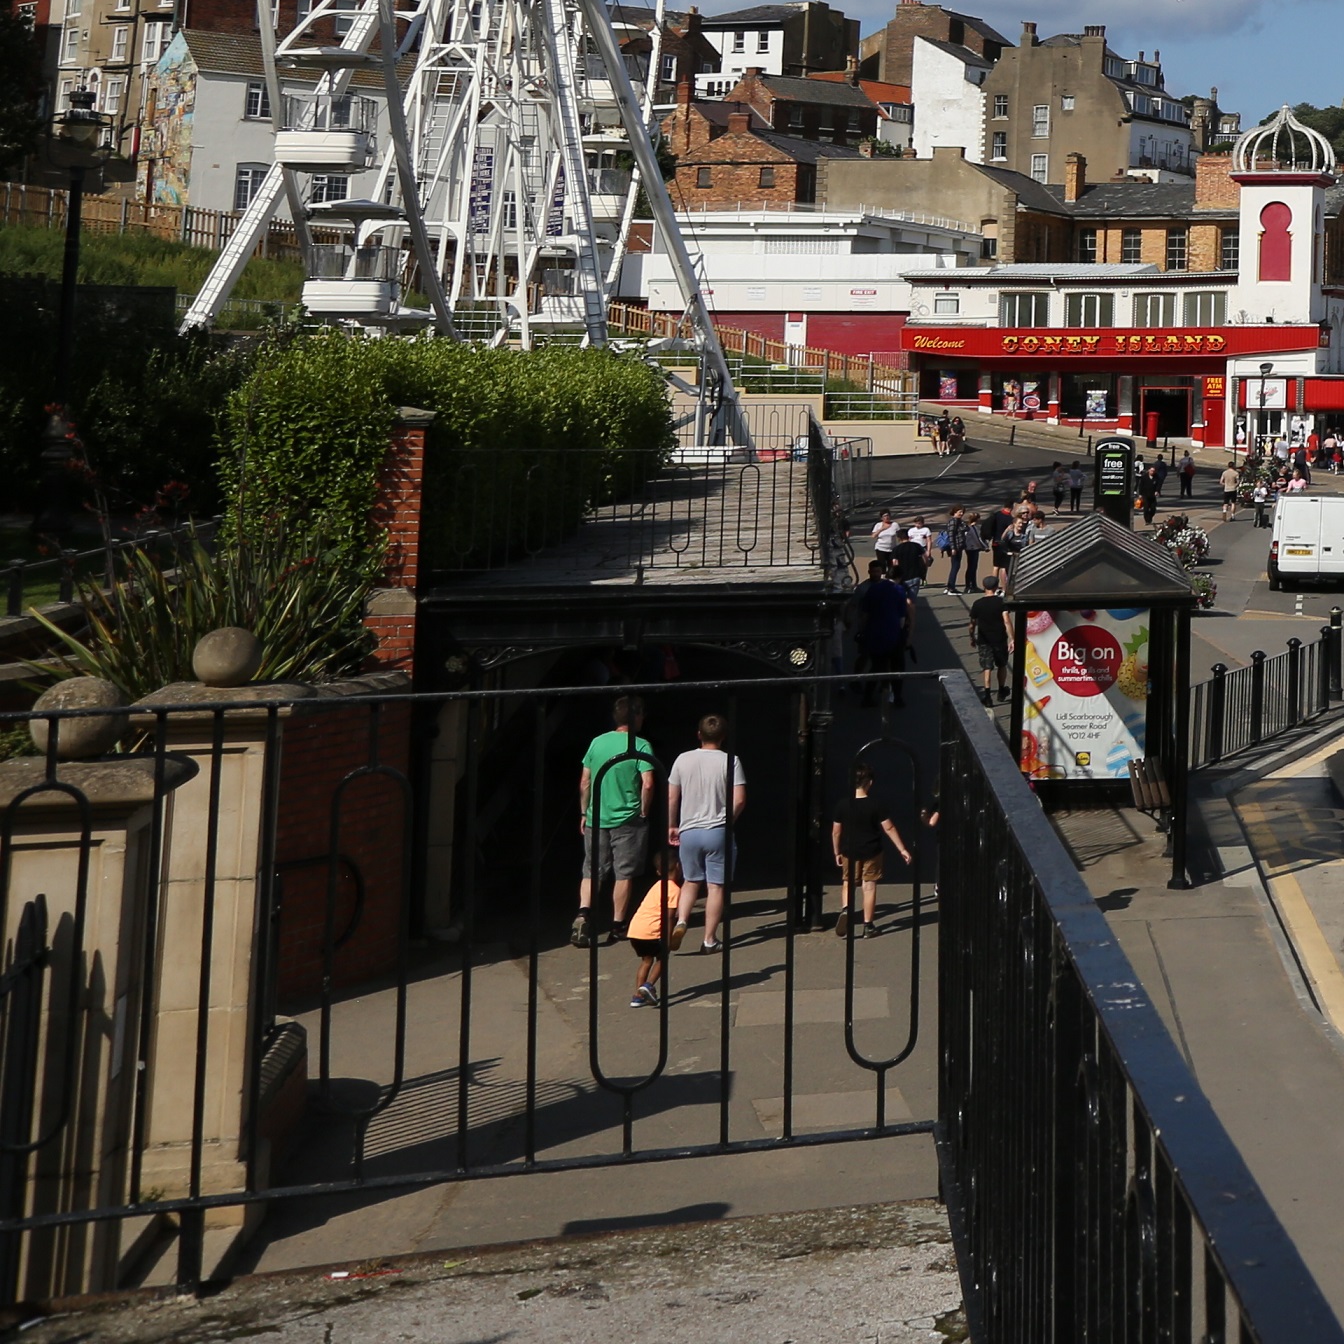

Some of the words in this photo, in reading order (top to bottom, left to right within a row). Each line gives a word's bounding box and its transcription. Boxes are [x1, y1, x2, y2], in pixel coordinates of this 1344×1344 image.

[914, 335, 965, 349] Welcome
[1002, 336, 1100, 353] CONEY
[1115, 335, 1226, 352] ISLAND
[1104, 459, 1123, 468] free
[1058, 641, 1087, 665] Big
[1092, 647, 1114, 660] on
[1069, 713, 1113, 723] Scarborough
